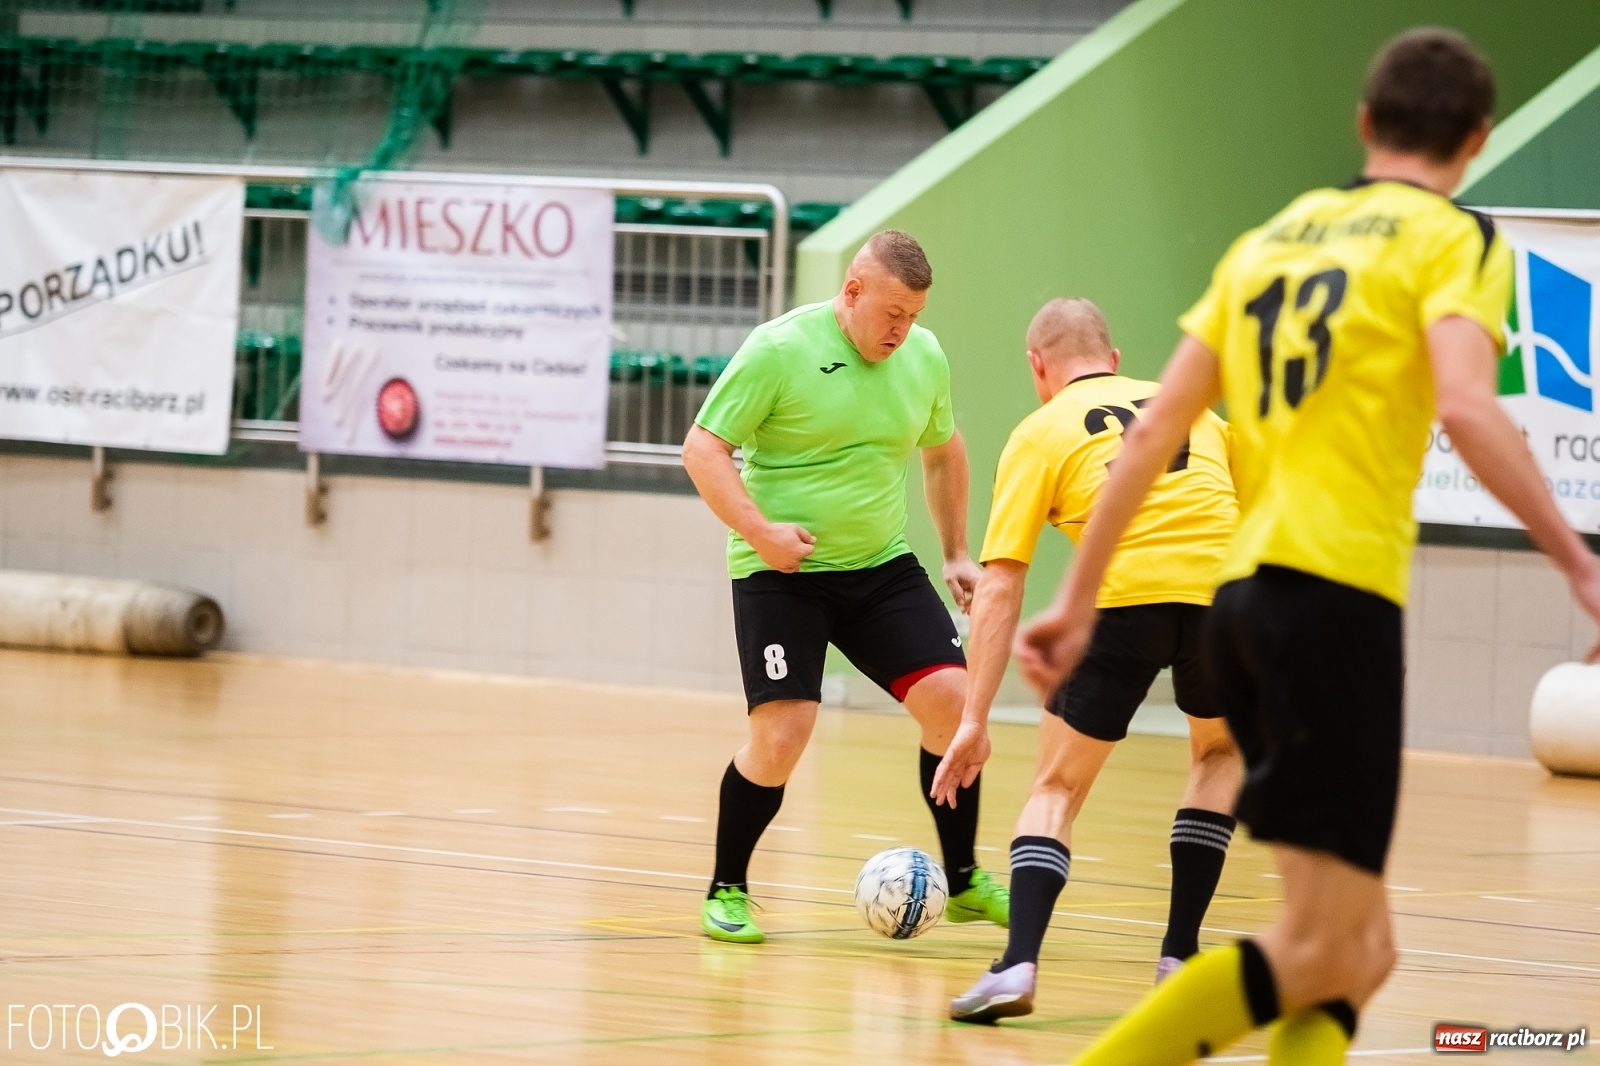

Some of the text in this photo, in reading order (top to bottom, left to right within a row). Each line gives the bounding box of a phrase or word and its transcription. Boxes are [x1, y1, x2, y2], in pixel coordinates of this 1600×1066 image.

[343, 196, 575, 261] MIESZKO
[1244, 267, 1348, 419] 13
[763, 643, 789, 681] 8
